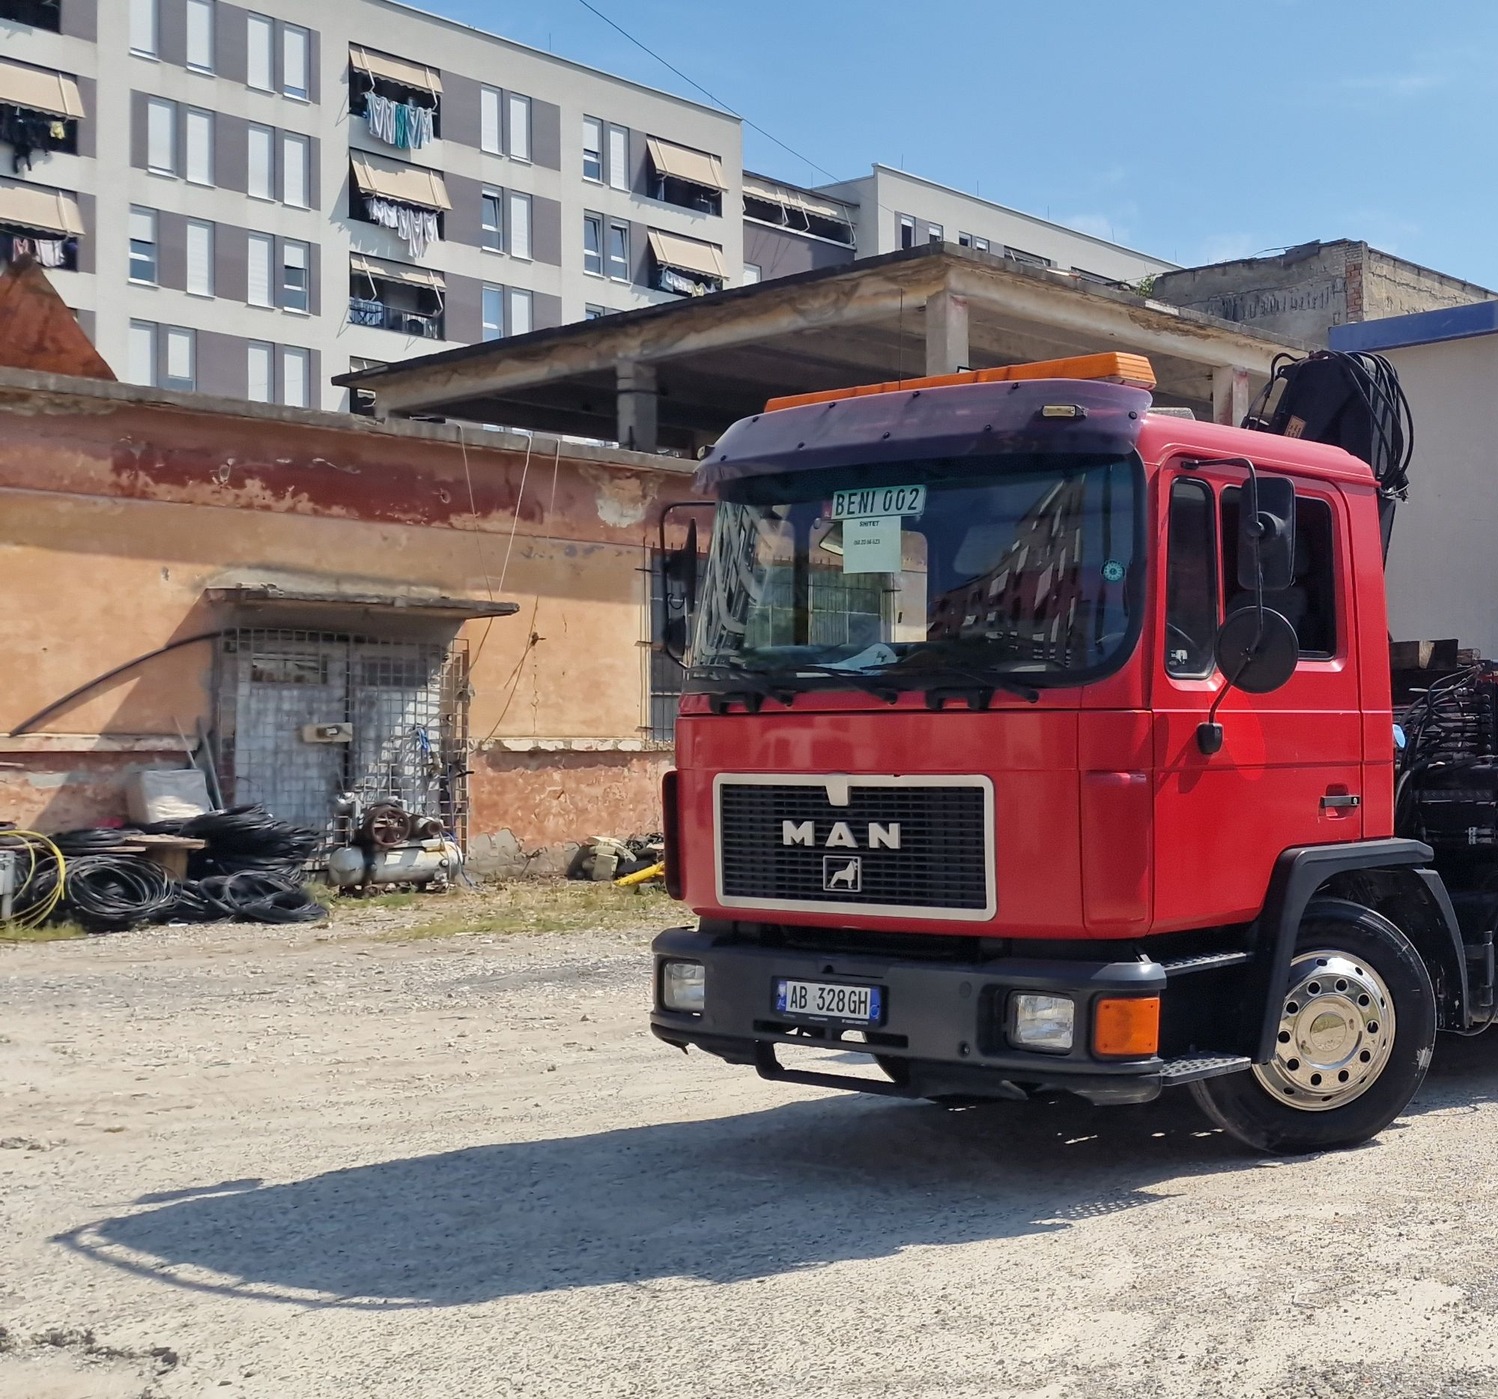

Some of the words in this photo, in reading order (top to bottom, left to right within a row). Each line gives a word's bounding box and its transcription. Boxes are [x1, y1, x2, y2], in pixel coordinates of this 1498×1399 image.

[835, 490, 876, 516] BENI
[882, 488, 919, 512] 002
[782, 820, 901, 849] MAN
[789, 985, 808, 1009] AB
